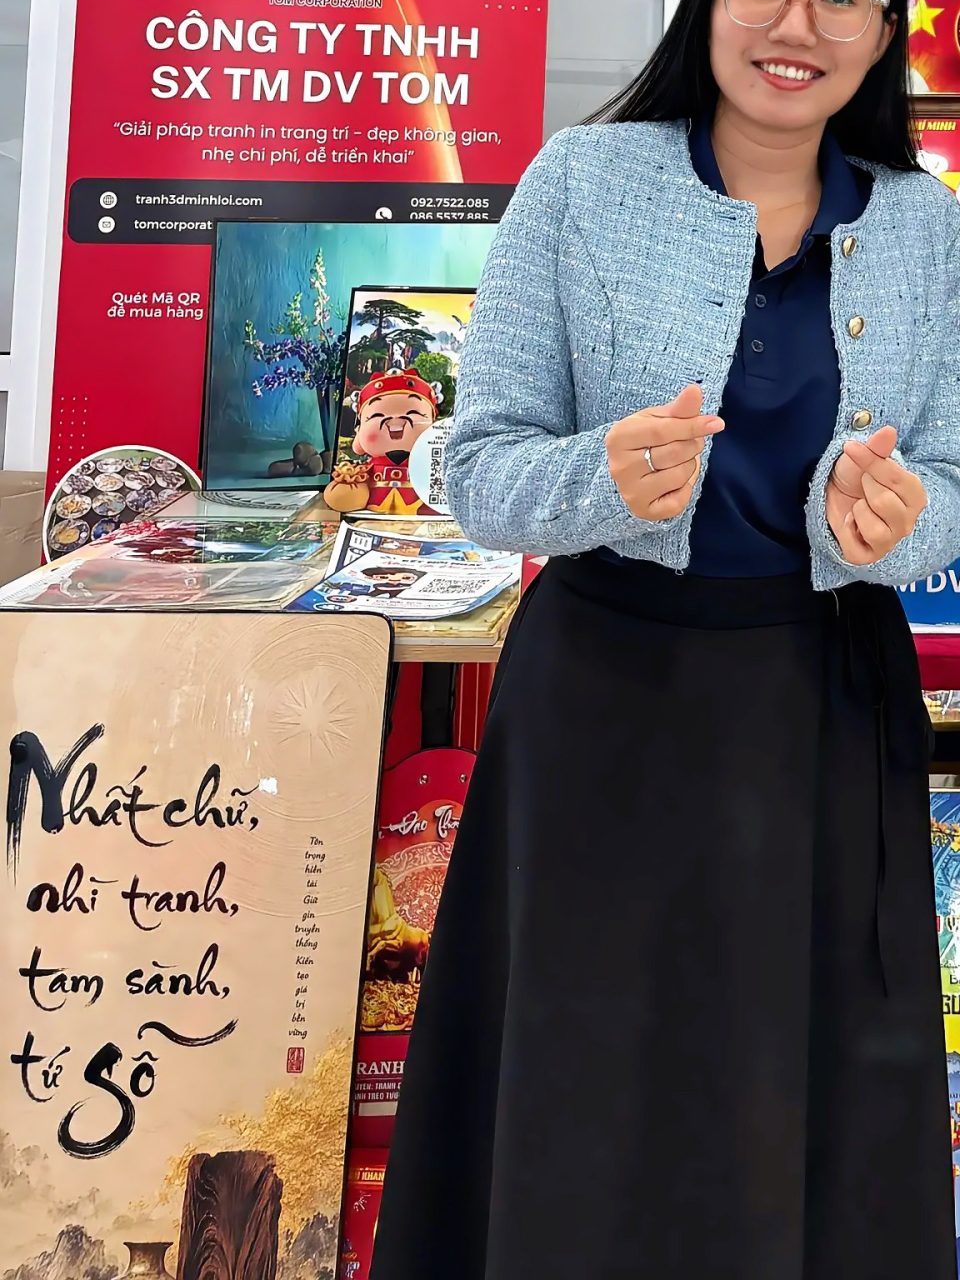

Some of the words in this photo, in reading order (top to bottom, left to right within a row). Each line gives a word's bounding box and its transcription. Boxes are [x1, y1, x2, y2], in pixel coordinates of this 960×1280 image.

[145, 10, 277, 54] CÔNG
[290, 22, 346, 55] TY
[355, 23, 479, 59] TNHH
[151, 65, 212, 100] SX
[223, 68, 289, 102] TM
[303, 70, 363, 103] DV
[373, 72, 469, 106] TOM
[113, 121, 151, 136] “Giải
[156, 123, 203, 140] pháp
[208, 124, 255, 138] tranh
[260, 124, 276, 139] in
[281, 126, 327, 144] trang
[332, 126, 349, 140] trí
[367, 127, 399, 145] đẹp
[404, 127, 456, 146] không
[461, 128, 502, 146] gian,
[927, 121, 956, 131] MINH
[201, 147, 234, 163] nhẹ
[239, 148, 265, 162] chi
[270, 148, 301, 166] phí,
[305, 146, 327, 163] dễ
[331, 147, 368, 163] triển
[373, 150, 414, 164] khai”
[410, 197, 489, 209] 092.7522.085
[112, 292, 148, 306] Quét
[152, 292, 173, 304] Mã
[178, 292, 200, 306] QR
[129, 308, 162, 317] mua
[166, 306, 203, 320] hàng
[6, 722, 173, 887] Nhất
[163, 763, 260, 832] chữ,
[121, 862, 239, 931] tranh,
[19, 946, 104, 1011] tam
[11, 1031, 71, 1102] tứ
[356, 1061, 405, 1075] RANH
